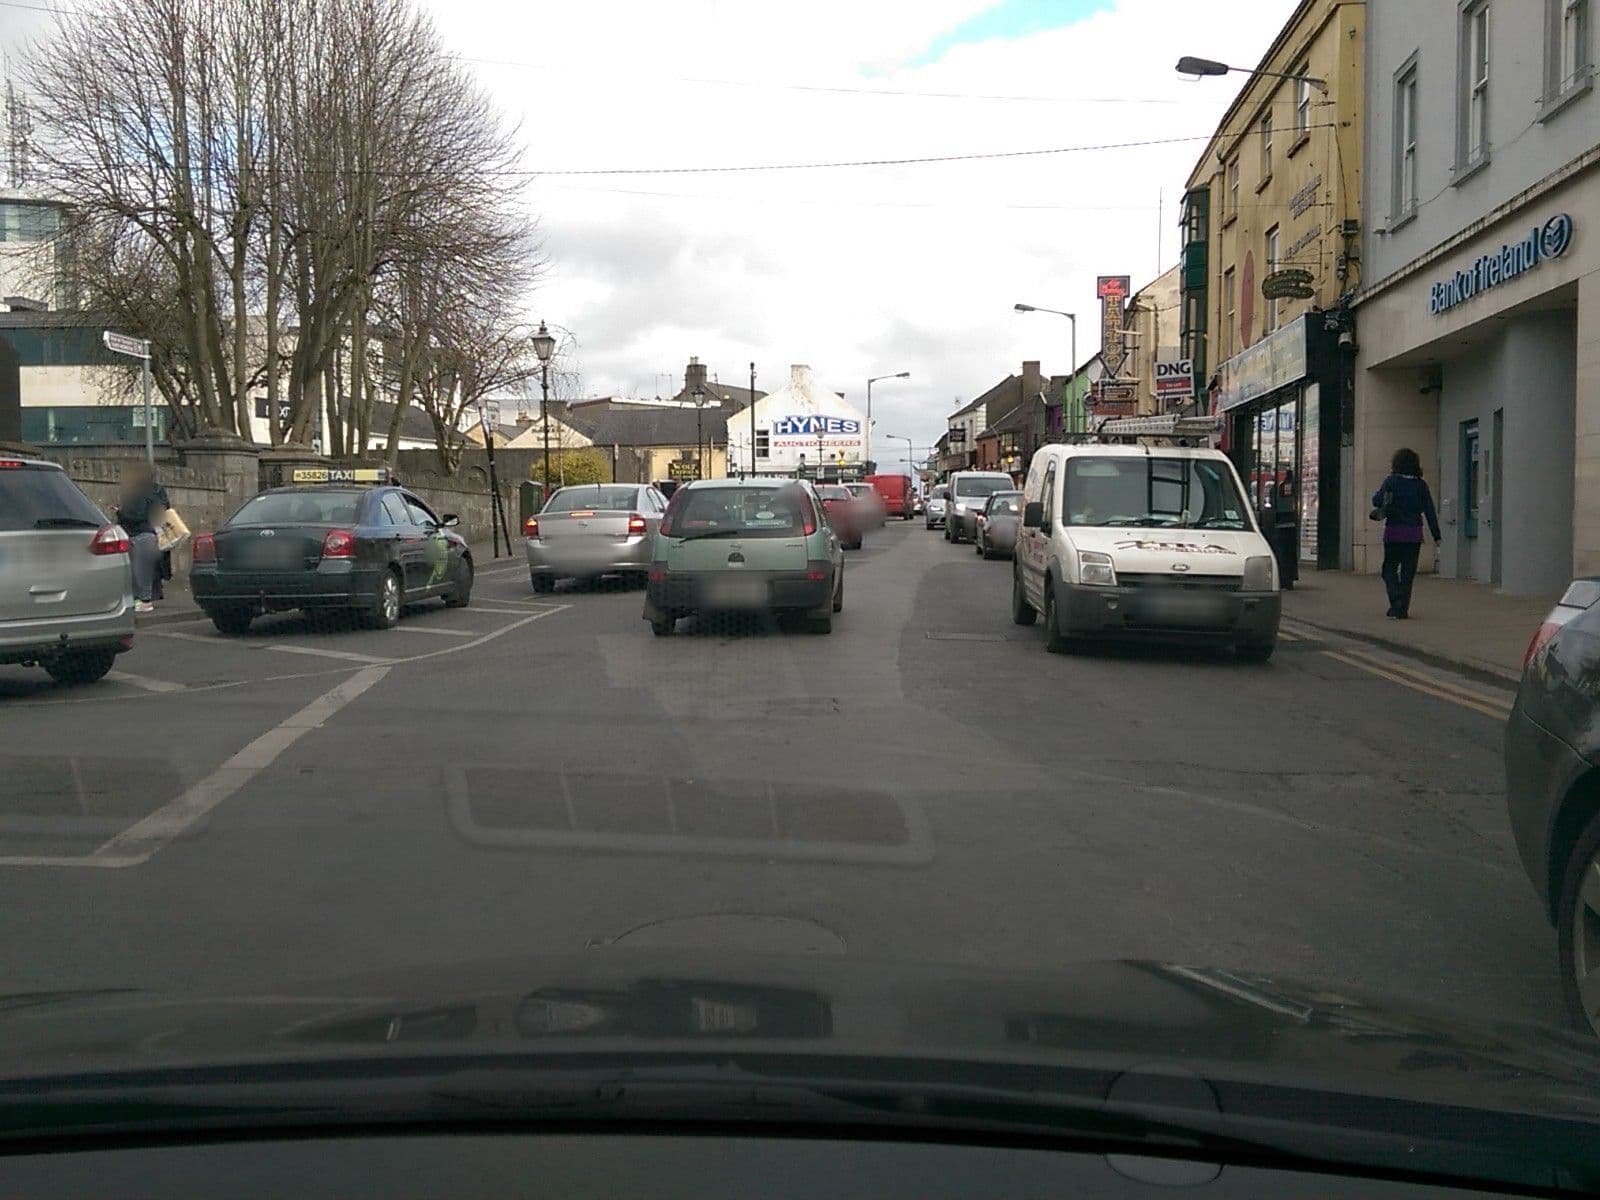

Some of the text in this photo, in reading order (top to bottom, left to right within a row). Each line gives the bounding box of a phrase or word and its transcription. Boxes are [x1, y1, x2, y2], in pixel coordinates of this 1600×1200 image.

[1429, 270, 1466, 315] Bank
[1480, 227, 1540, 291] Ireland
[1157, 361, 1191, 376] DNG
[777, 416, 857, 433] HYNES
[329, 470, 354, 480] TAXI
